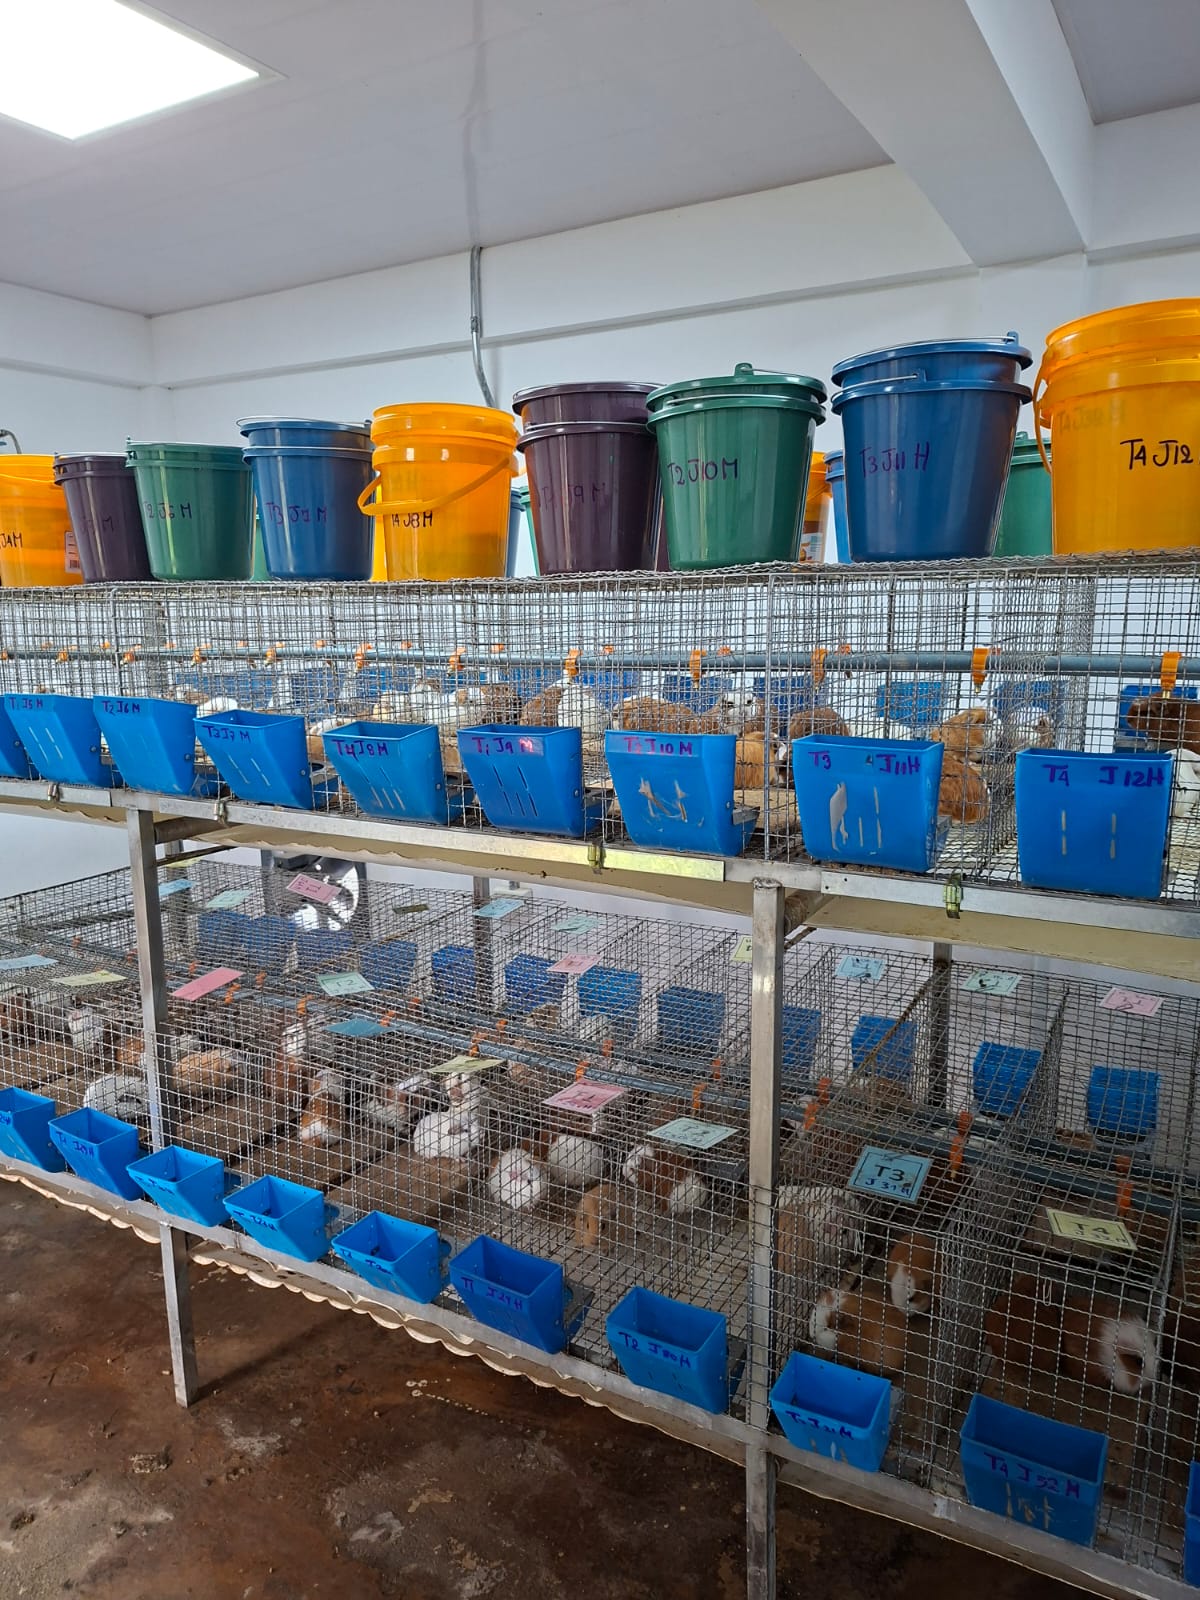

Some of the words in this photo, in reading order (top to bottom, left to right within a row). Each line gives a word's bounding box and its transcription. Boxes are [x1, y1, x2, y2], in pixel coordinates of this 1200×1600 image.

[859, 446, 878, 478] T3
[667, 462, 685, 485] T2
[808, 750, 831, 770] T3
[874, 1164, 906, 1182] T3
